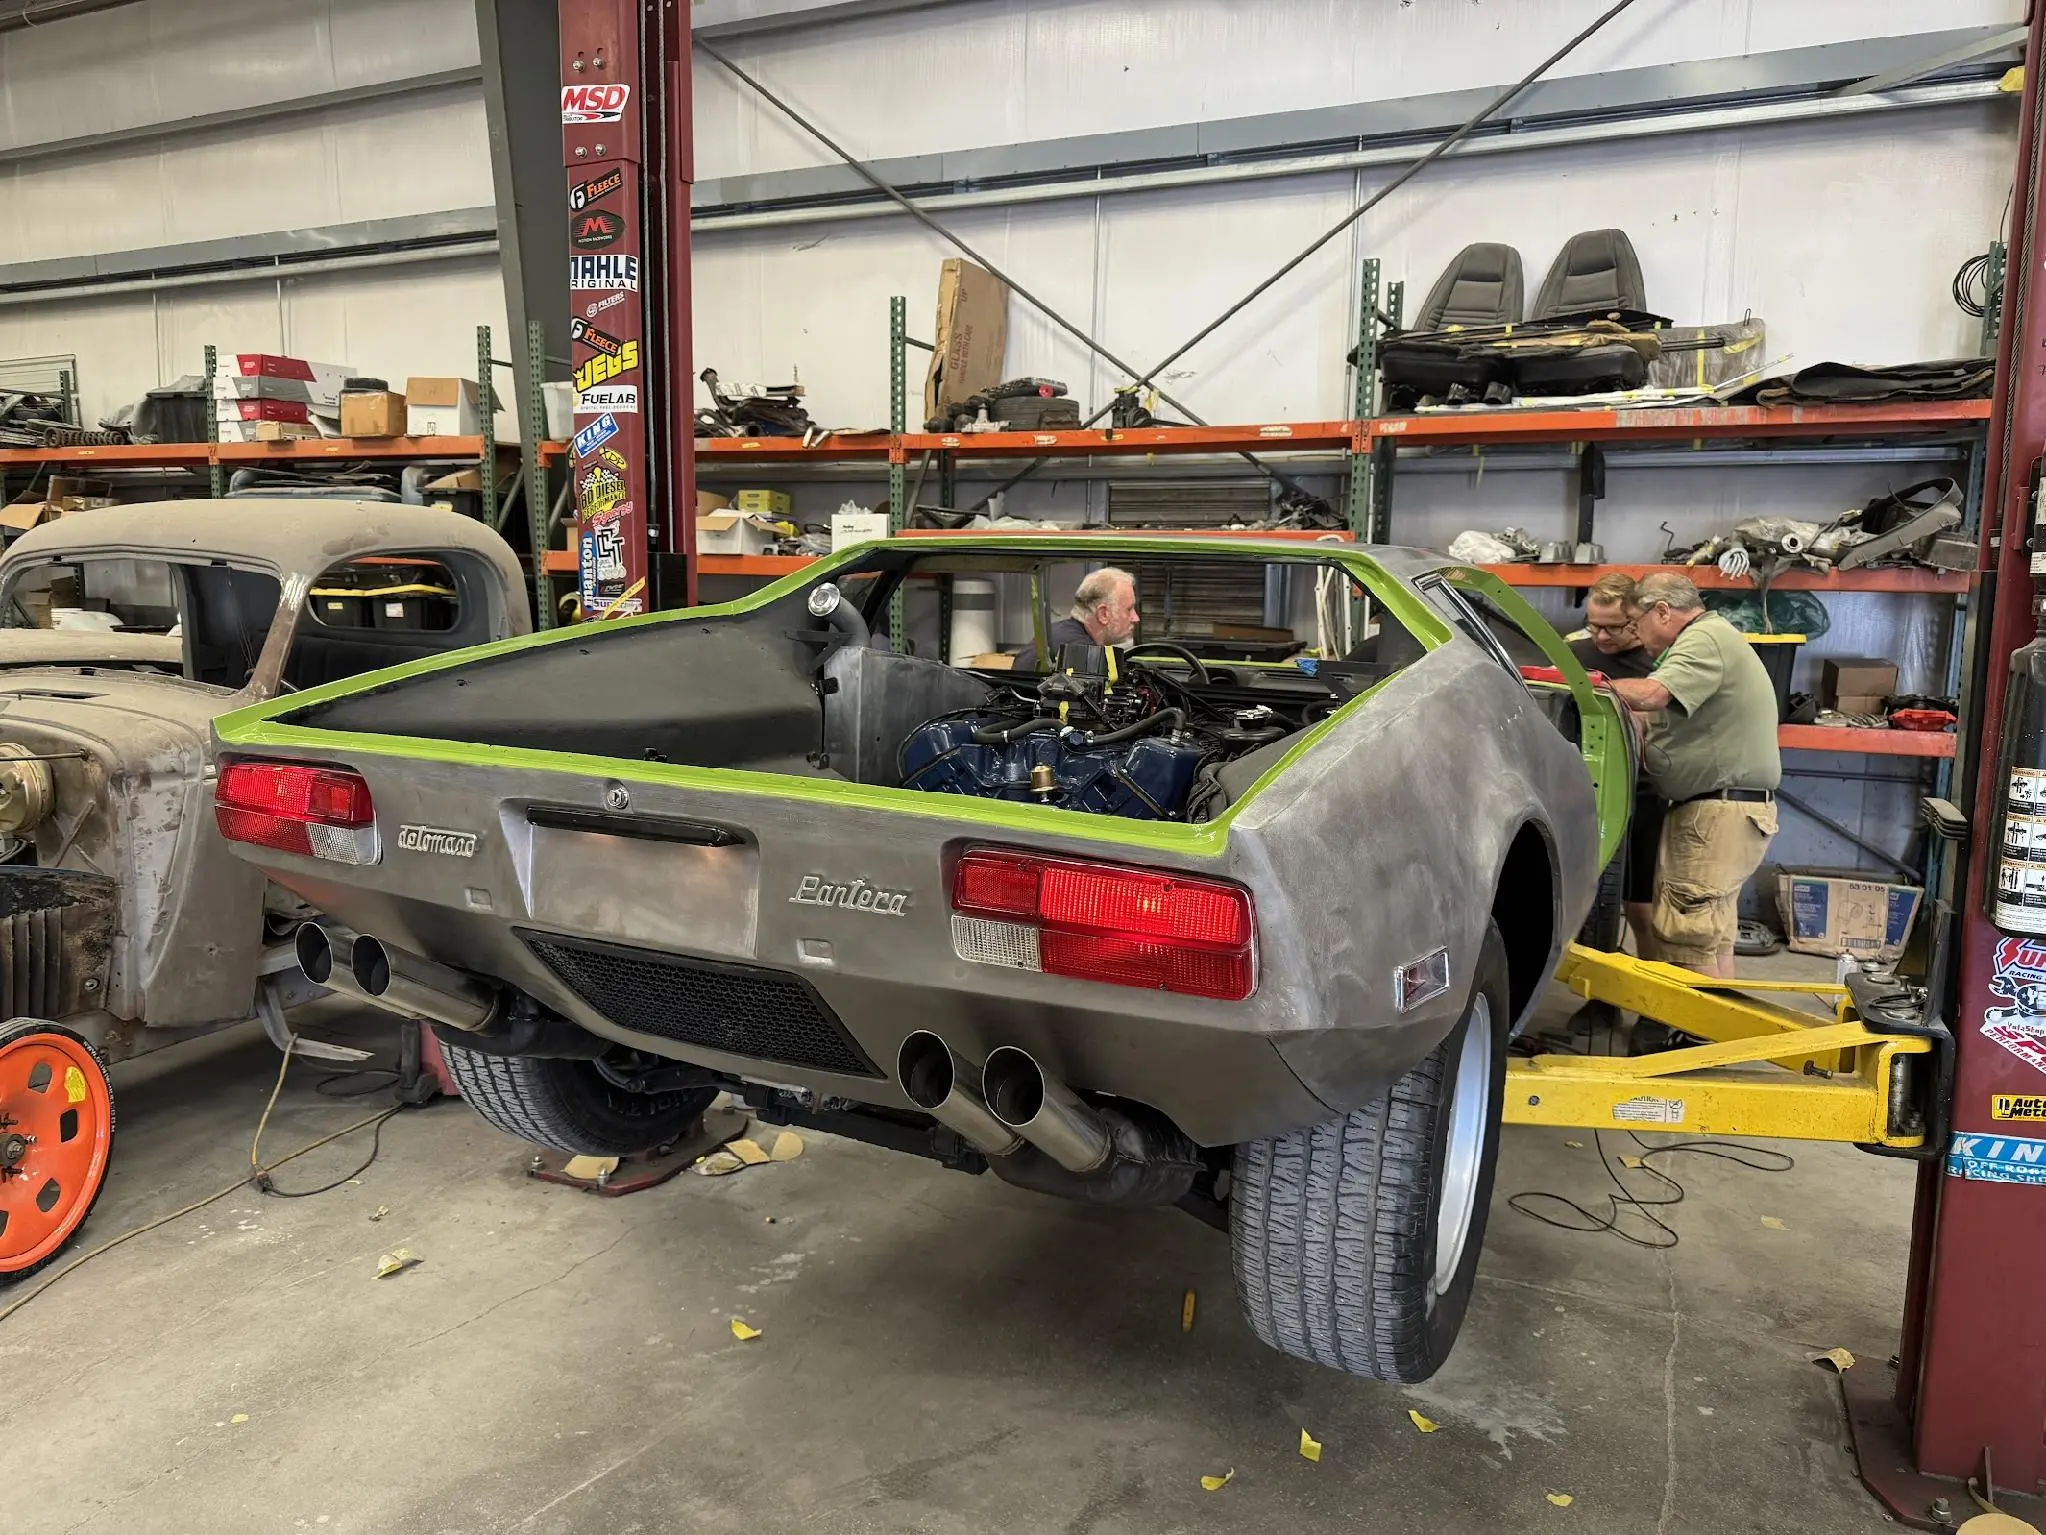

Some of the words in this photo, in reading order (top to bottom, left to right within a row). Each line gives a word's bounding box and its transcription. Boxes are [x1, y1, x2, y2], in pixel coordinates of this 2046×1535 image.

[563, 86, 625, 110] MSD
[587, 173, 620, 198] FLEECE
[584, 328, 618, 353] FLEECE
[950, 333, 963, 370] GLASS
[581, 392, 636, 405] FUELAB
[577, 415, 612, 448] KING
[599, 447, 625, 466] XDP
[595, 480, 624, 500] DIESEL
[583, 537, 594, 608] manton
[789, 876, 908, 917] Pantera
[2008, 970, 2043, 980] RACING
